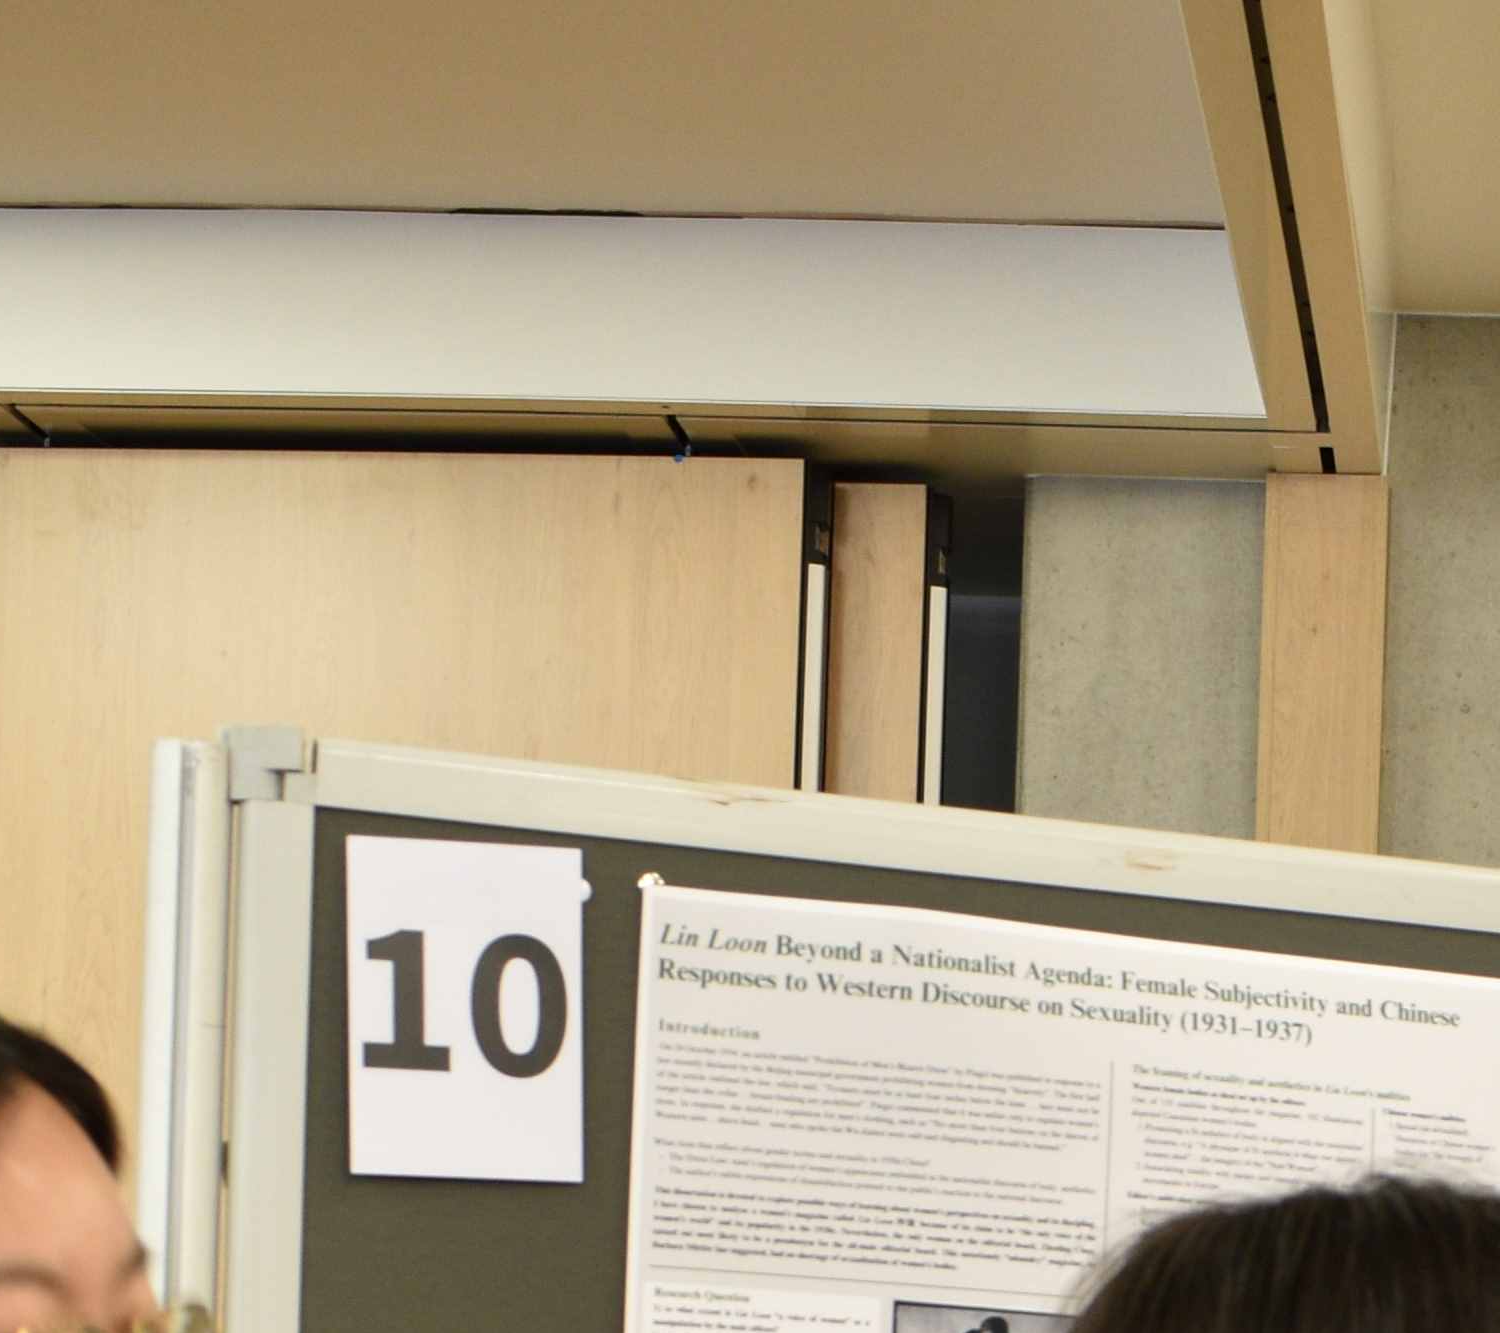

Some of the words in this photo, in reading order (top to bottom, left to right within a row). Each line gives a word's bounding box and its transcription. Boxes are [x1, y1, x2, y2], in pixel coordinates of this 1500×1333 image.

[362, 929, 567, 1079] 10
[657, 958, 777, 988] Responses
[785, 973, 807, 991] to
[816, 973, 912, 999] Western
[921, 982, 1030, 1011] Discourse
[1037, 1000, 1063, 1015] on
[1070, 999, 1171, 1031] Sexuality
[660, 923, 699, 946] Lin
[707, 929, 767, 953] Loon
[776, 935, 862, 962] Beyond
[870, 949, 883, 963] a
[892, 945, 1015, 975] Nationalist
[1025, 963, 1112, 987] Agenda:
[1121, 971, 1197, 997] Female
[1204, 982, 1327, 1015] Subjectivity
[1336, 999, 1372, 1017] and
[1379, 1001, 1460, 1026] Chinese
[658, 1019, 759, 1038] Introduction
